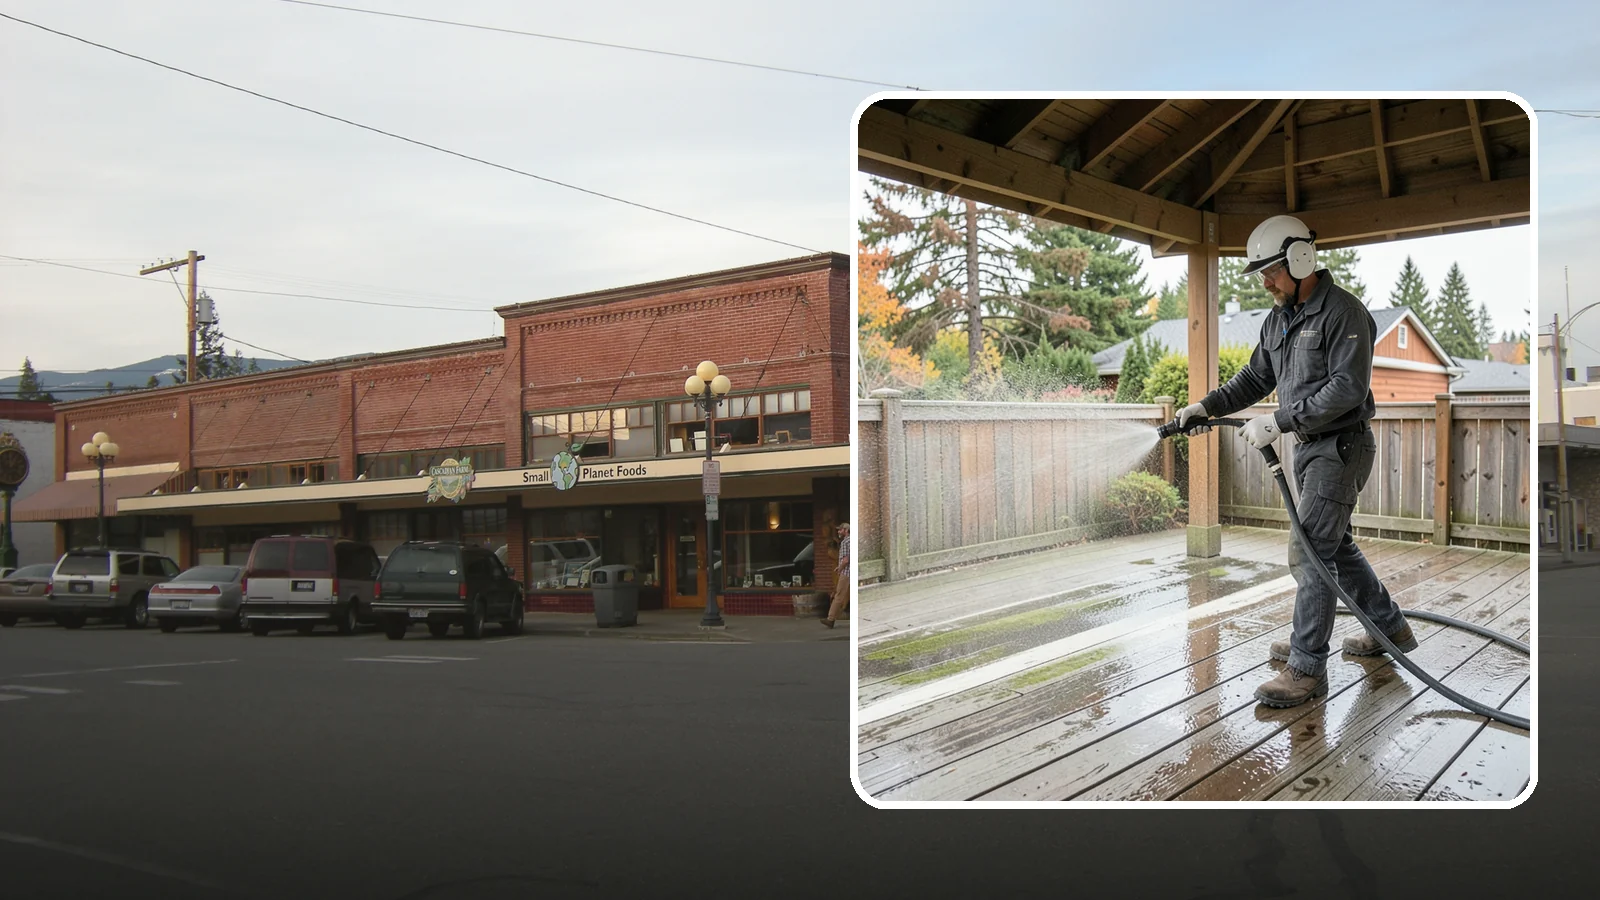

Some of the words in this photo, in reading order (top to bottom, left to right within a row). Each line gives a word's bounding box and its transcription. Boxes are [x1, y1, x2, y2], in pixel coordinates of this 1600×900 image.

[523, 471, 549, 483] Small
[583, 467, 614, 479] Planet
[617, 464, 647, 476] Foods
